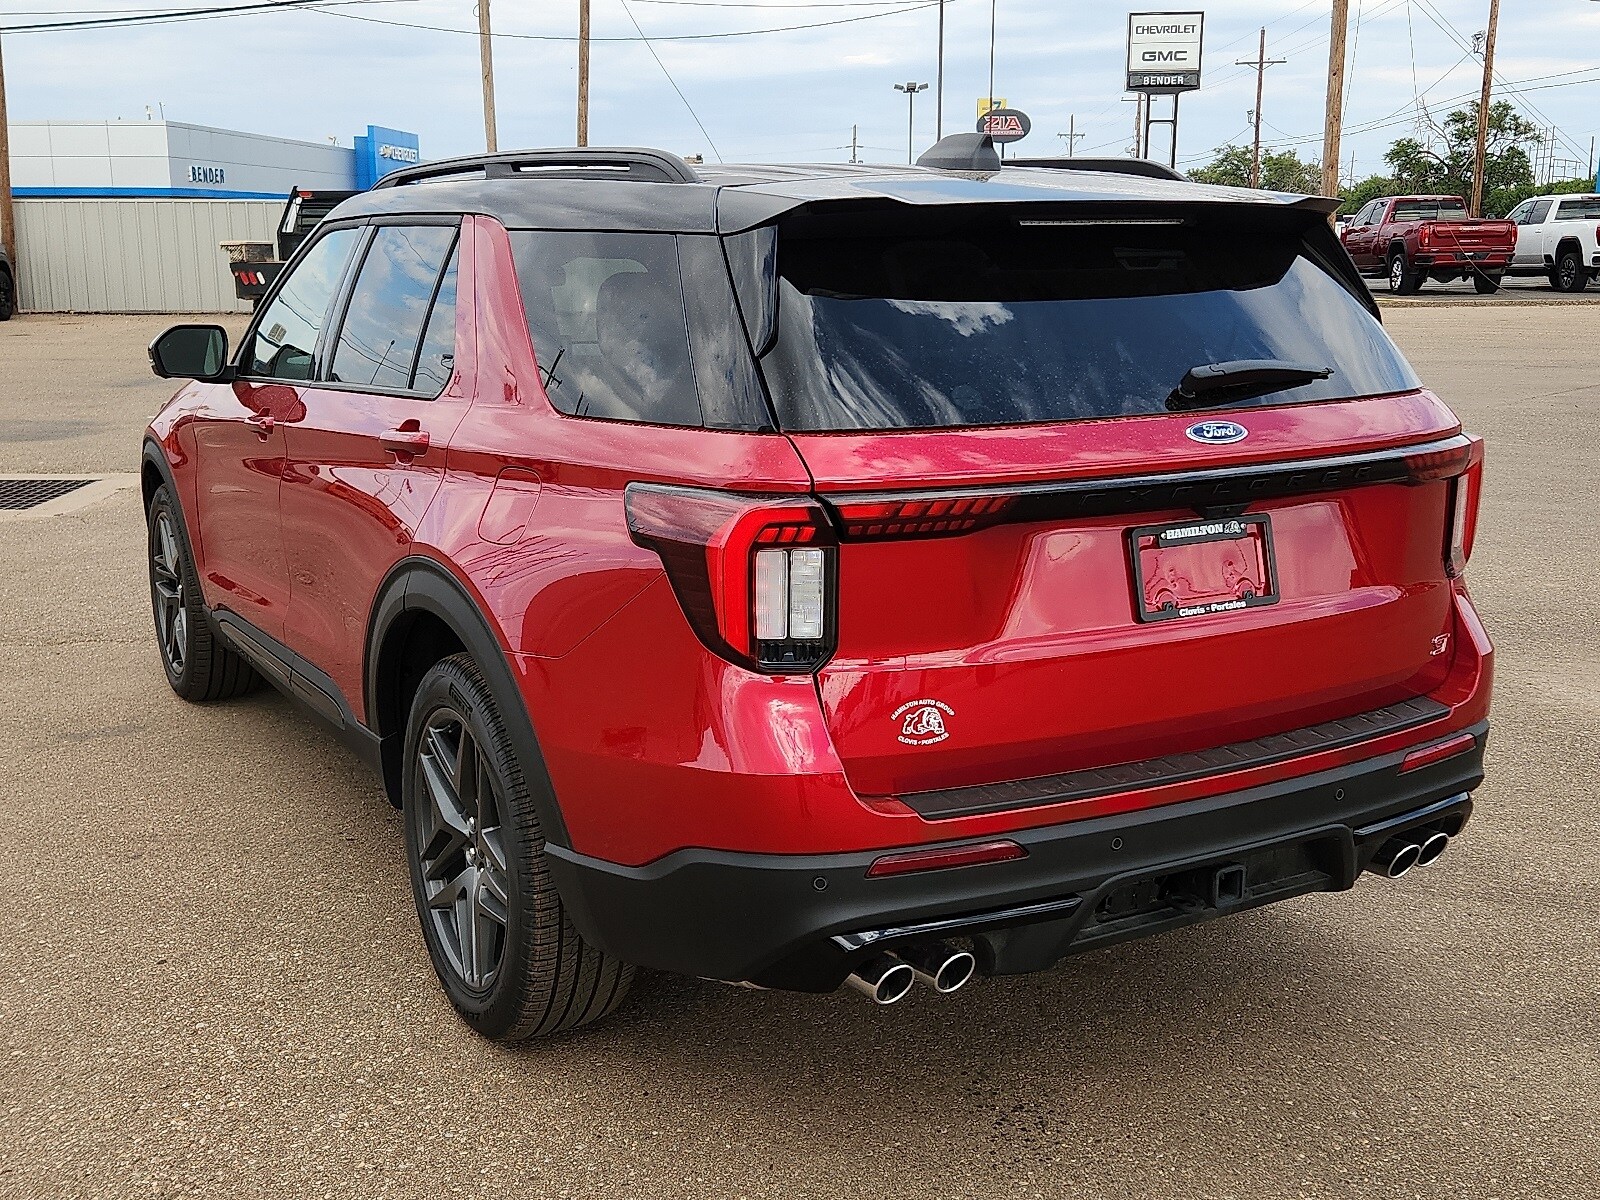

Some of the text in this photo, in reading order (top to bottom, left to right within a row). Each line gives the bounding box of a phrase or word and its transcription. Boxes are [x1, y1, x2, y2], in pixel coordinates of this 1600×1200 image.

[1135, 24, 1197, 35] CHEVROLET
[1142, 50, 1187, 62] GMC
[1143, 76, 1184, 86] BENDER
[983, 115, 1023, 131] ZIA
[190, 165, 225, 184] BENDER
[1202, 424, 1236, 438] Ford
[1080, 465, 1372, 506] EXPLORER
[1165, 523, 1224, 540] HAMILTON
[1179, 600, 1247, 617] Clovis Portales
[890, 700, 919, 721] HAMILTON
[935, 701, 955, 716] GROUP
[897, 732, 950, 746] CLOVIS PORTALES
